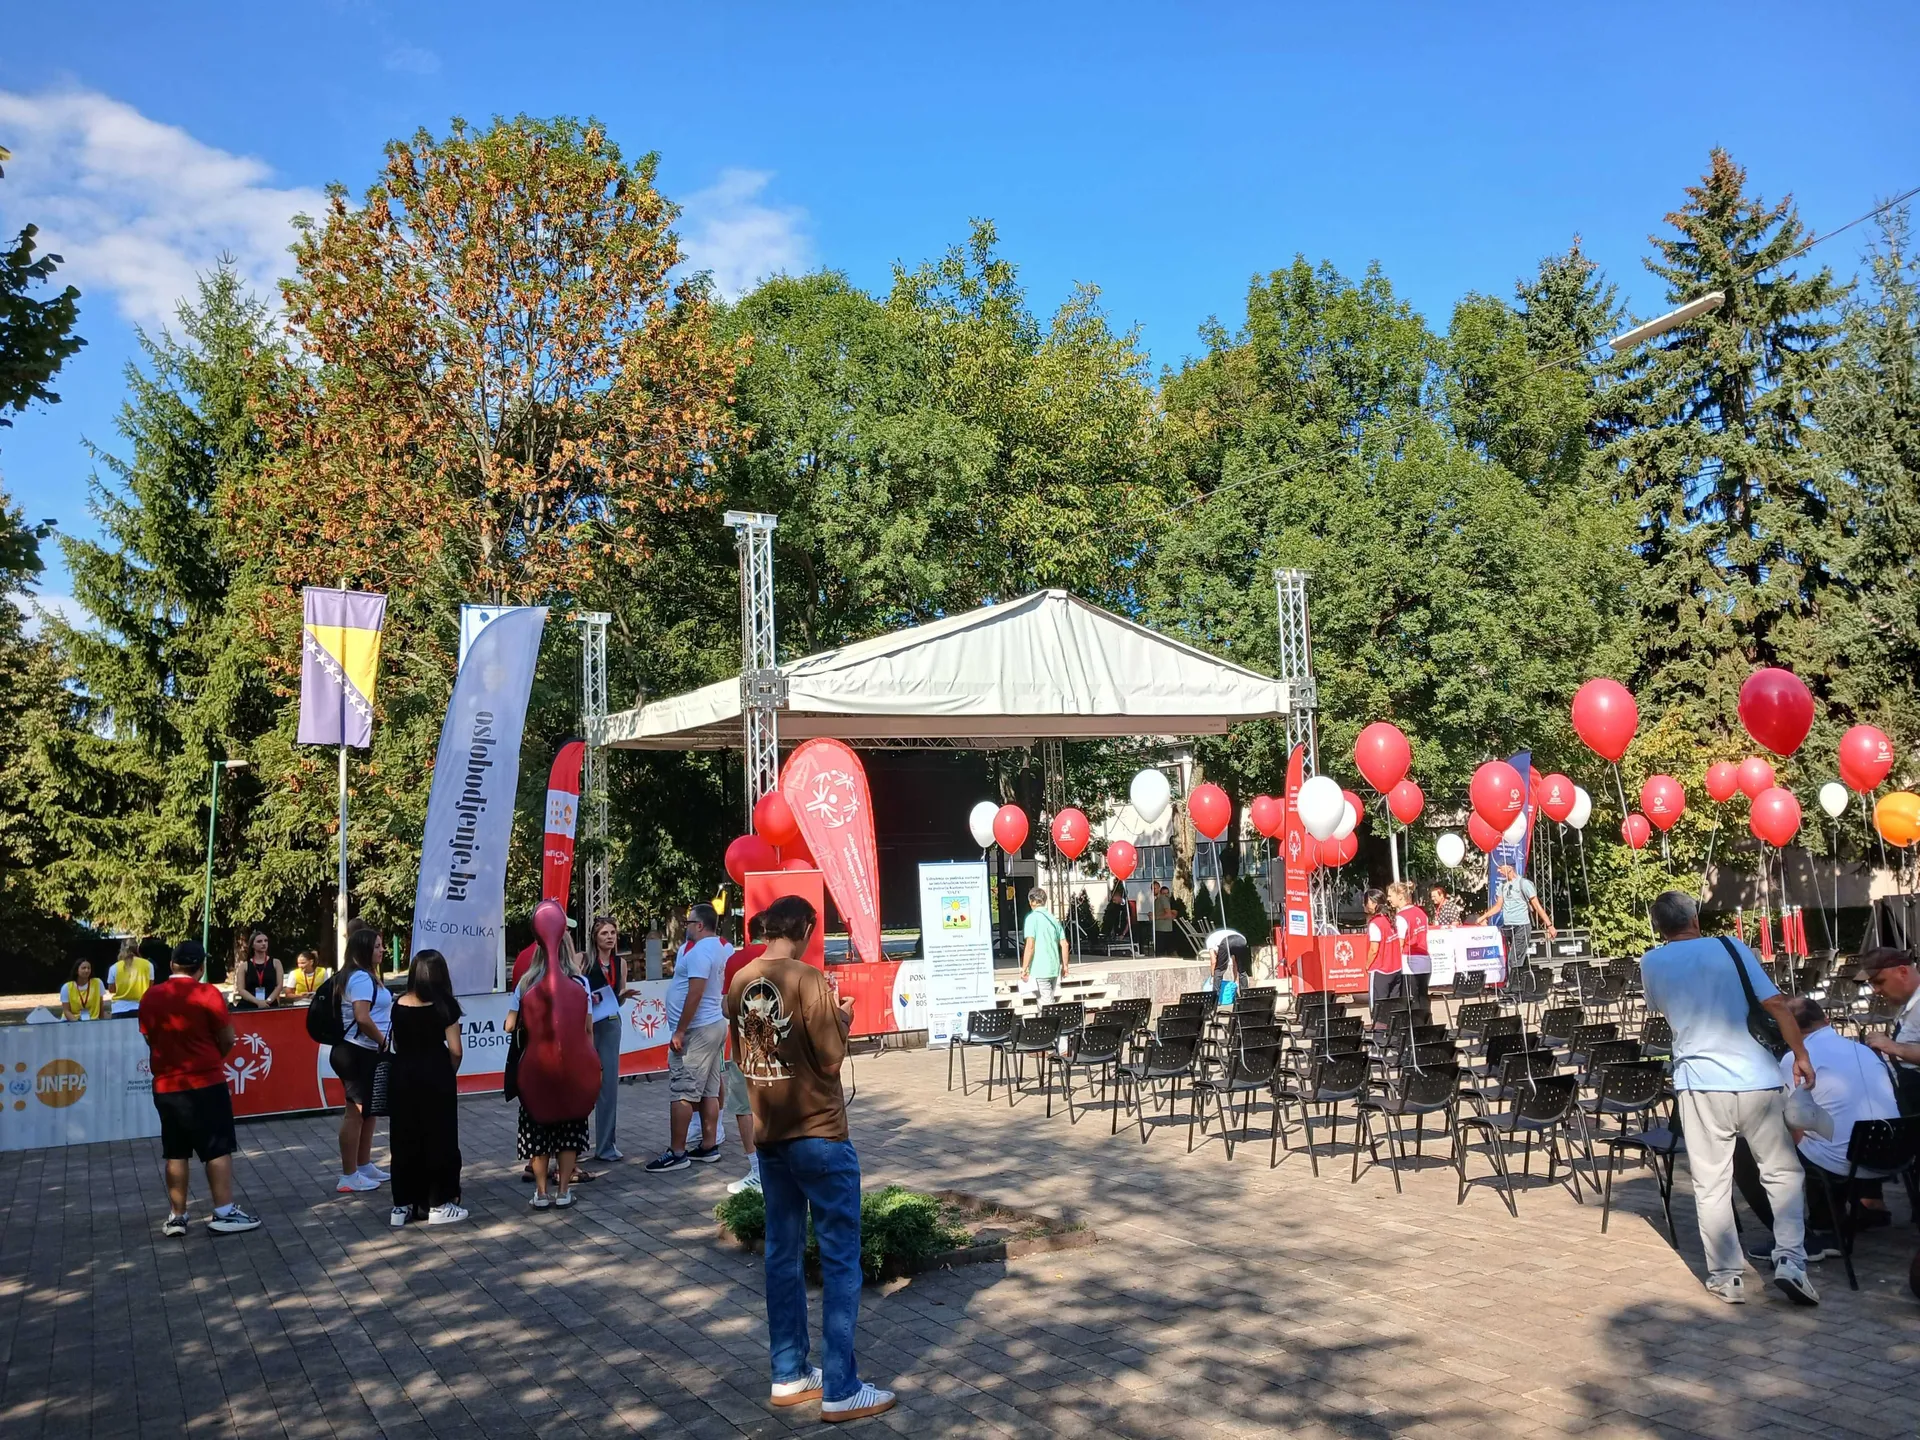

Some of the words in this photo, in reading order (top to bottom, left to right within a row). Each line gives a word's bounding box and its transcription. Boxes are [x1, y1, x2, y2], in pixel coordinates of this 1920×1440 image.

[446, 710, 497, 902] oslobodjenje.ba
[418, 918, 438, 933] VIŠE
[440, 922, 458, 934] OD
[462, 924, 495, 937] KLIKA
[468, 1034, 512, 1048] Bosne
